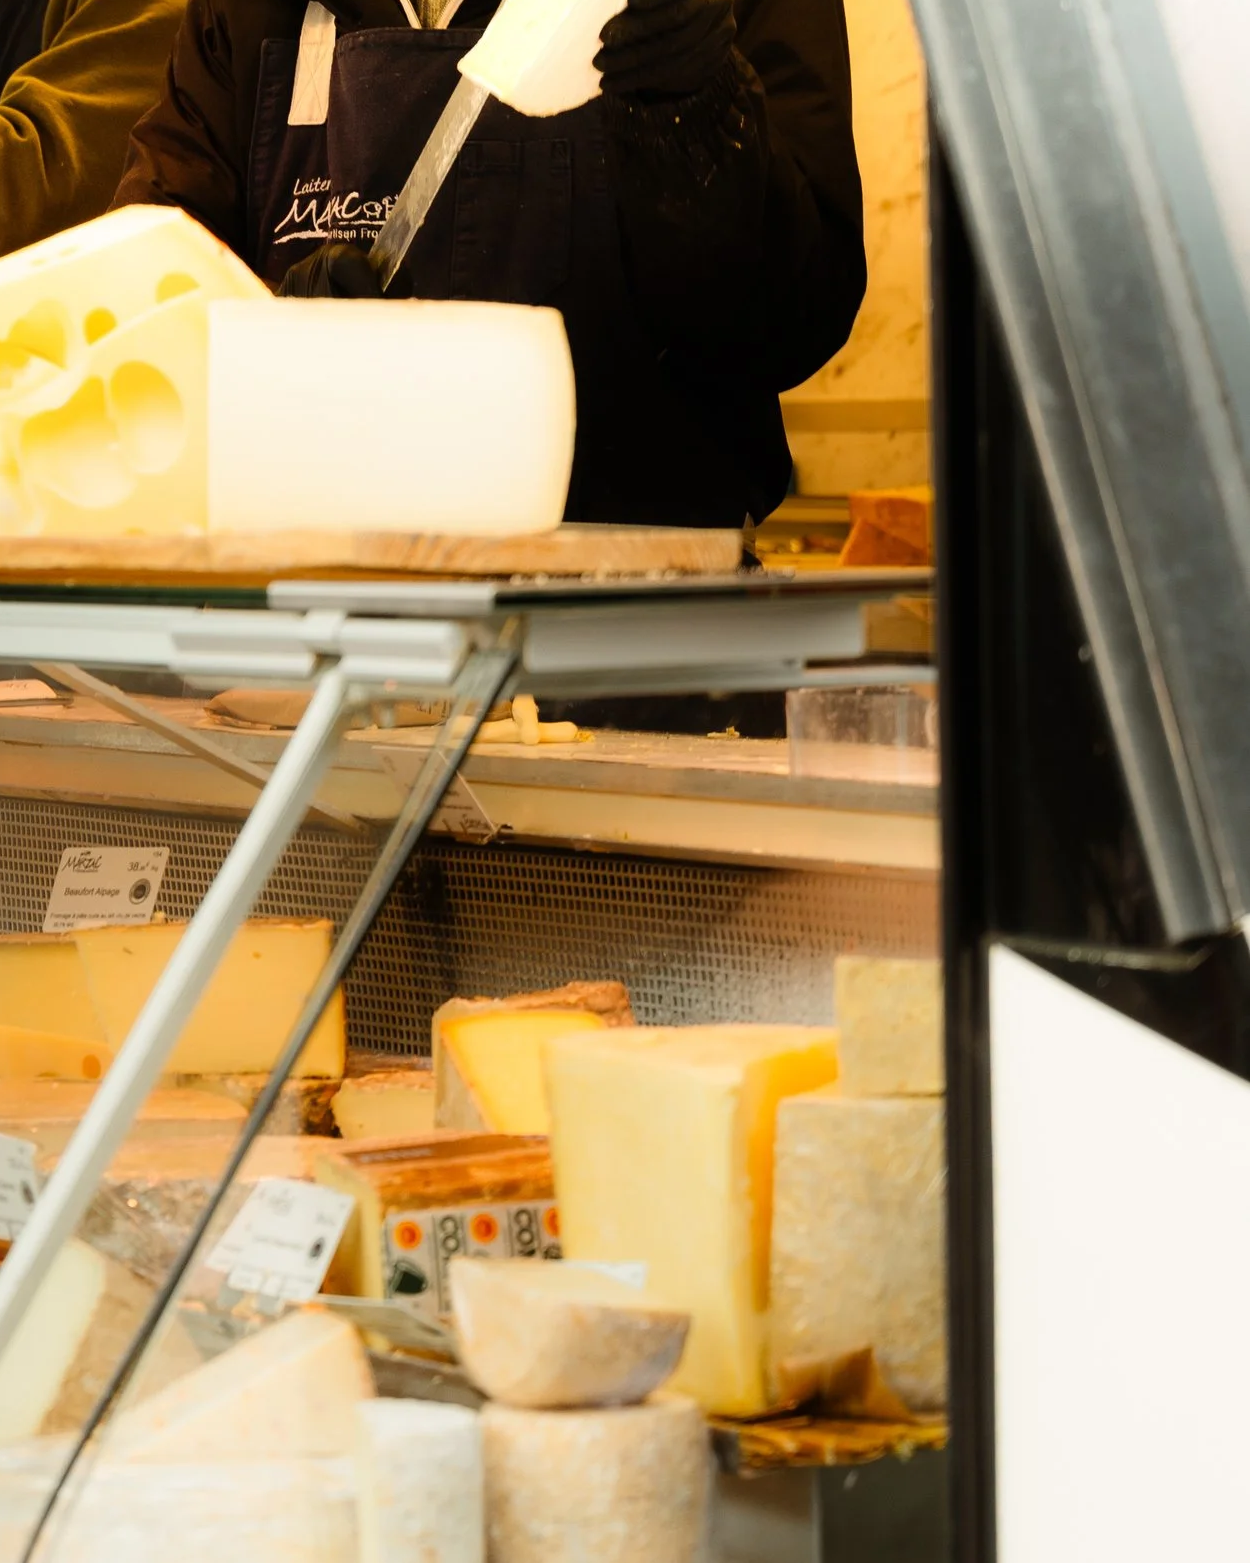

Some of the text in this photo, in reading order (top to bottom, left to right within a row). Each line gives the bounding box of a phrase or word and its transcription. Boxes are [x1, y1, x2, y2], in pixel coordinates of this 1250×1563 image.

[360, 227, 382, 239] Fro
[64, 887, 120, 898] Beaufort Alpage
